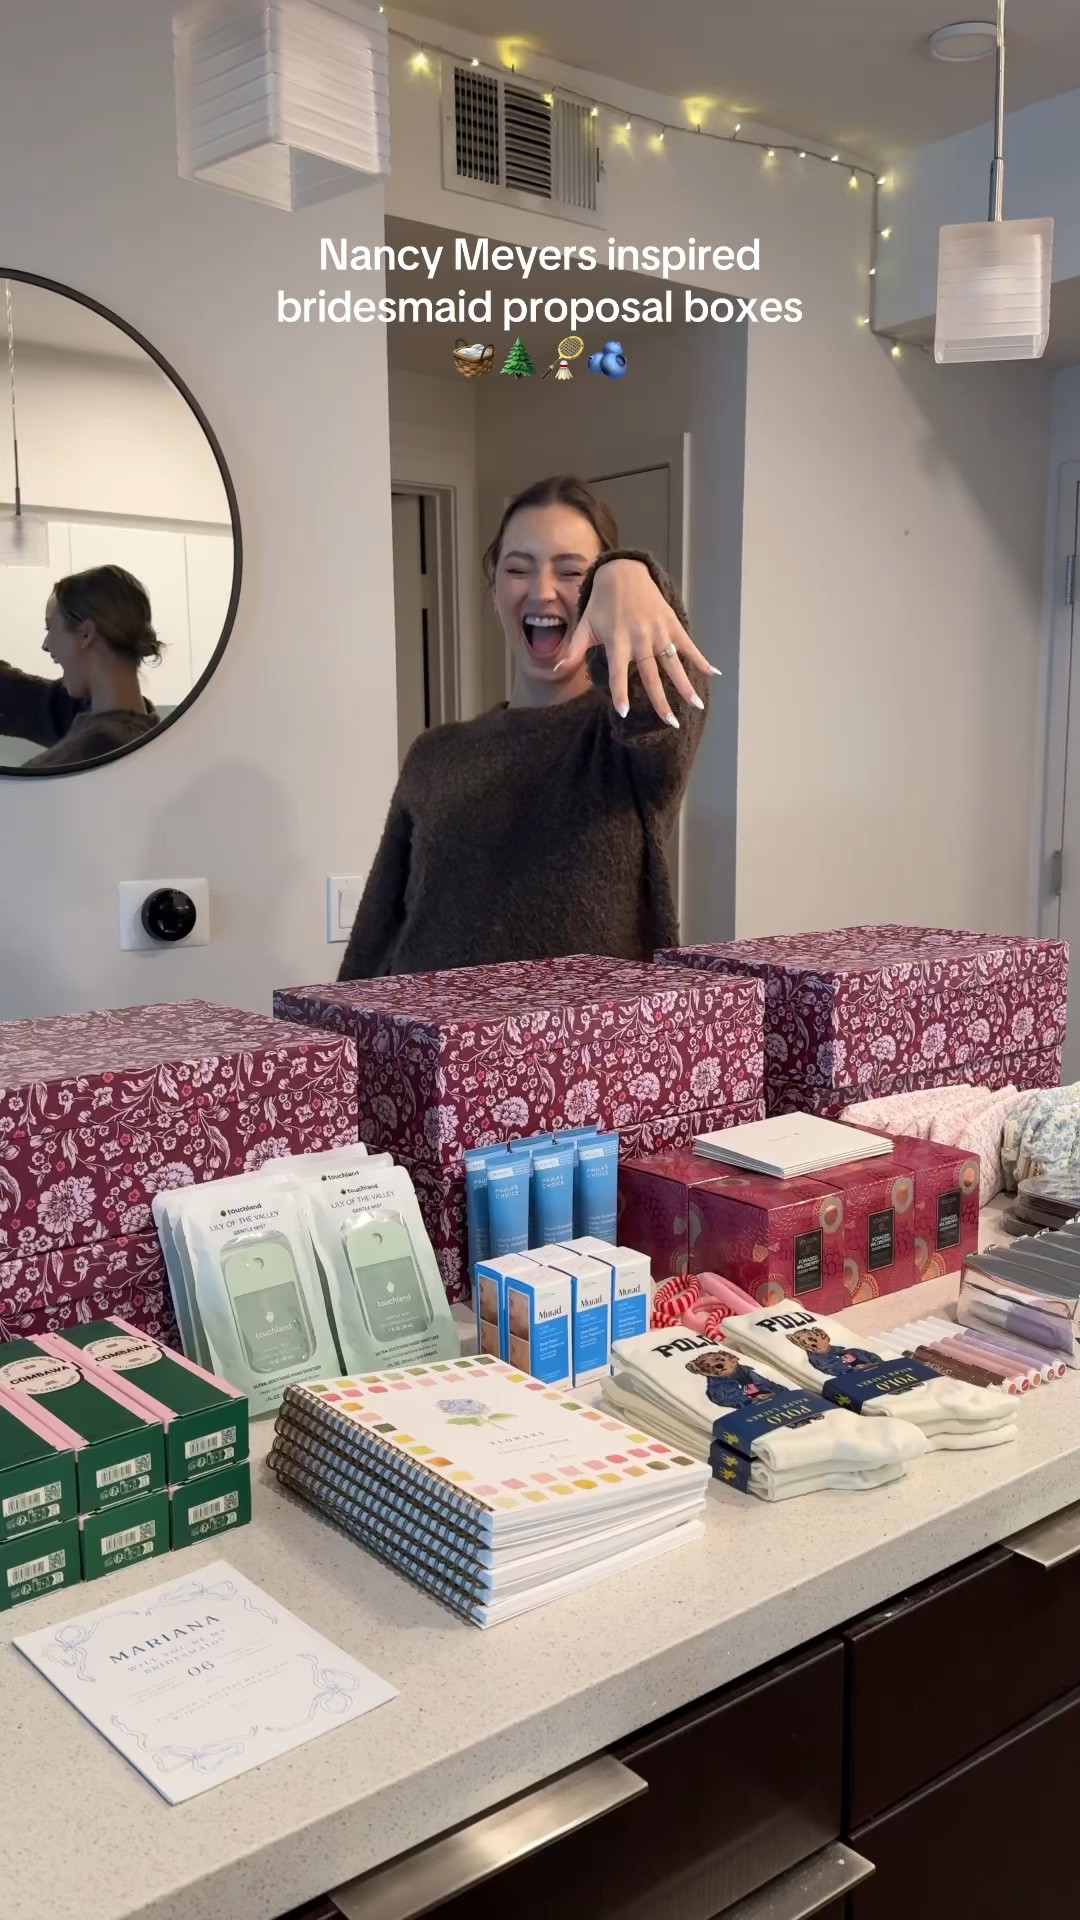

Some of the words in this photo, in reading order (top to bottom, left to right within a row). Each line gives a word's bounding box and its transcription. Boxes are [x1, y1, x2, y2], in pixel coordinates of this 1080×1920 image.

[328, 1170, 359, 1180] touchland
[347, 1183, 379, 1194] touchland
[495, 1190, 519, 1200] CHOICE
[357, 1195, 370, 1203] THE
[370, 1190, 394, 1200] VALLEY
[227, 1203, 262, 1215] touchland
[209, 1223, 224, 1232] LILY
[226, 1220, 237, 1228] OF
[238, 1215, 252, 1225] THE
[253, 1210, 279, 1221] VALLEY
[619, 1284, 641, 1297] Murad
[376, 1293, 411, 1308] touchland
[580, 1294, 603, 1308] Murad
[538, 1305, 562, 1321] Murad
[255, 1321, 292, 1340] touchland
[94, 1343, 152, 1363] COMBAWA
[9, 1364, 71, 1385] COMBAWA
[875, 1374, 919, 1393] POLO
[766, 1404, 812, 1426] POLO
[109, 1615, 220, 1664] MARIANA
[127, 1657, 156, 1672] WILL
[187, 1660, 215, 1677] 06
